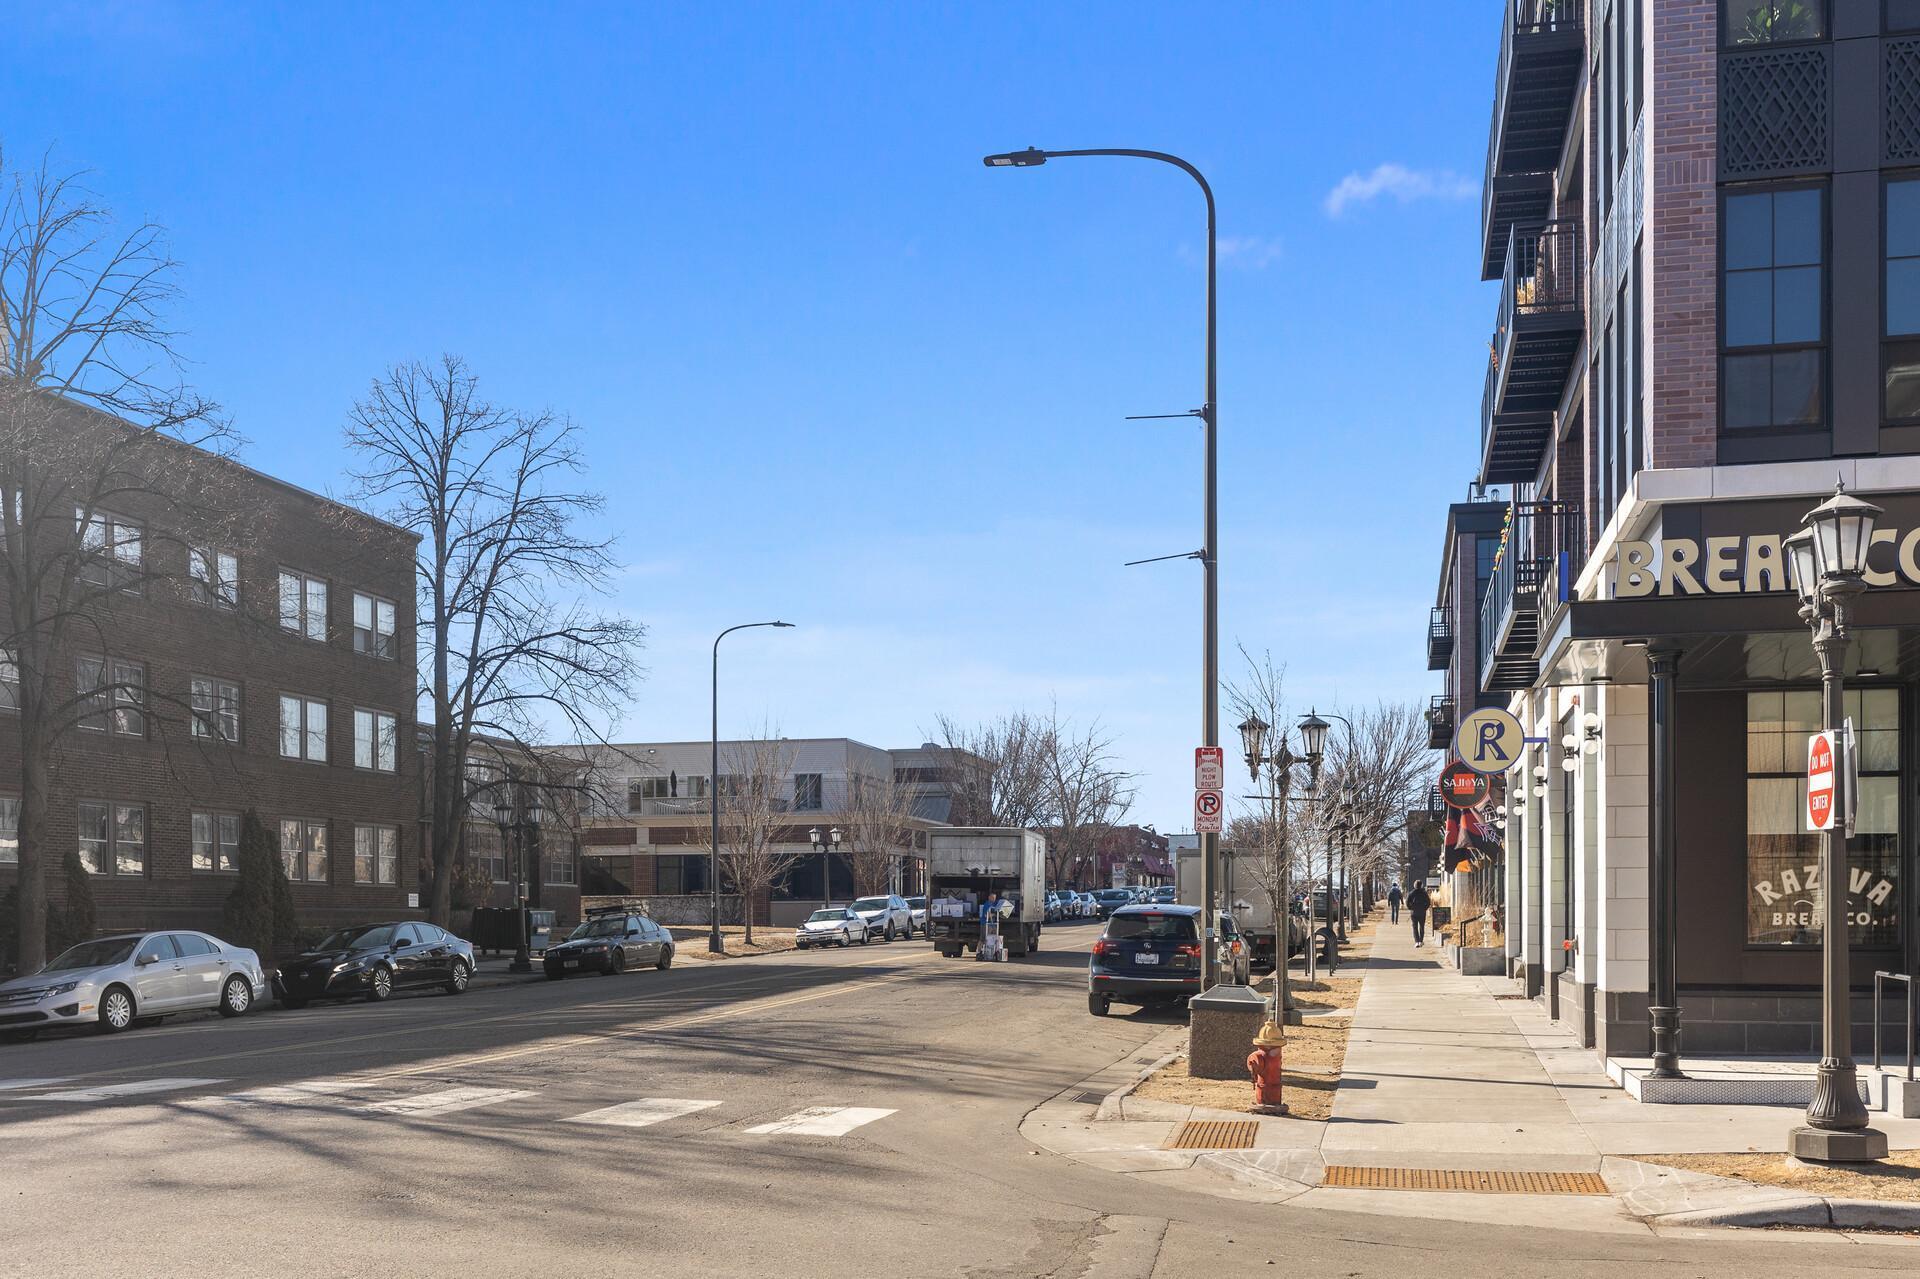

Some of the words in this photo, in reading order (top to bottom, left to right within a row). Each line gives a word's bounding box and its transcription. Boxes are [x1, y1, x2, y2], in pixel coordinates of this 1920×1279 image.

[1615, 534, 1800, 598] BREA
[1473, 718, 1509, 761] R
[1811, 756, 1819, 770] DO
[1819, 752, 1830, 768] NOT
[1812, 794, 1829, 810] ENTER
[1754, 865, 1893, 906] RAZVA
[1772, 912, 1824, 926] BREA
